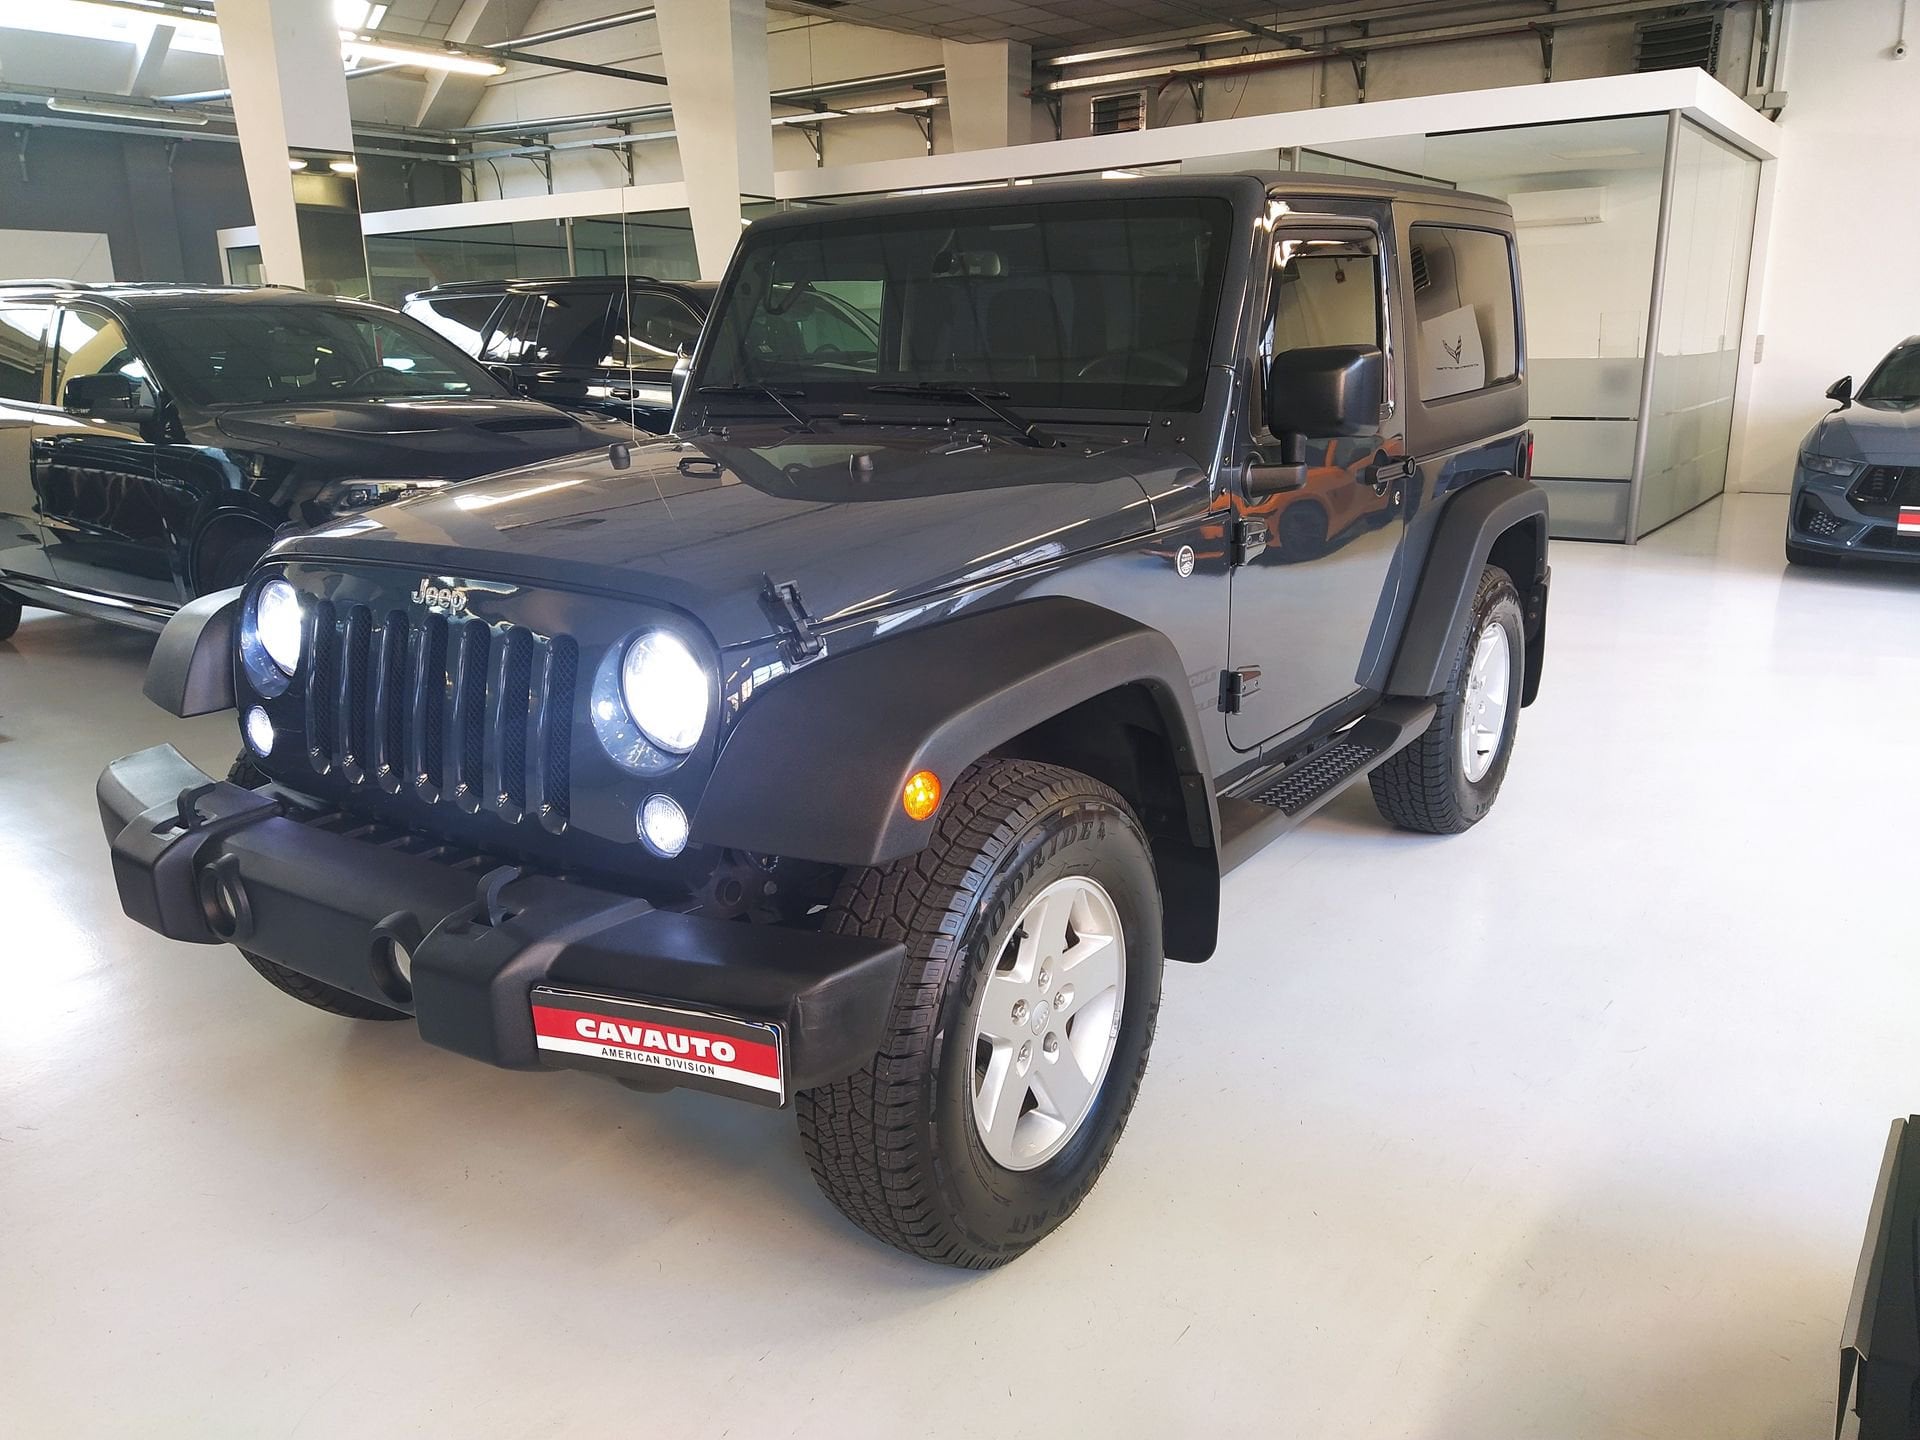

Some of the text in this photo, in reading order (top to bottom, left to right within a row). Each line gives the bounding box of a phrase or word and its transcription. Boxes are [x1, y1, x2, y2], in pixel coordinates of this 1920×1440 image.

[1709, 23, 1723, 75] penGroup
[411, 578, 467, 615] Jeep
[960, 821, 1095, 1007] GOODRIDE
[575, 1018, 736, 1062] CAVAUTO
[602, 1047, 715, 1076] AMERICAN DIVISION
